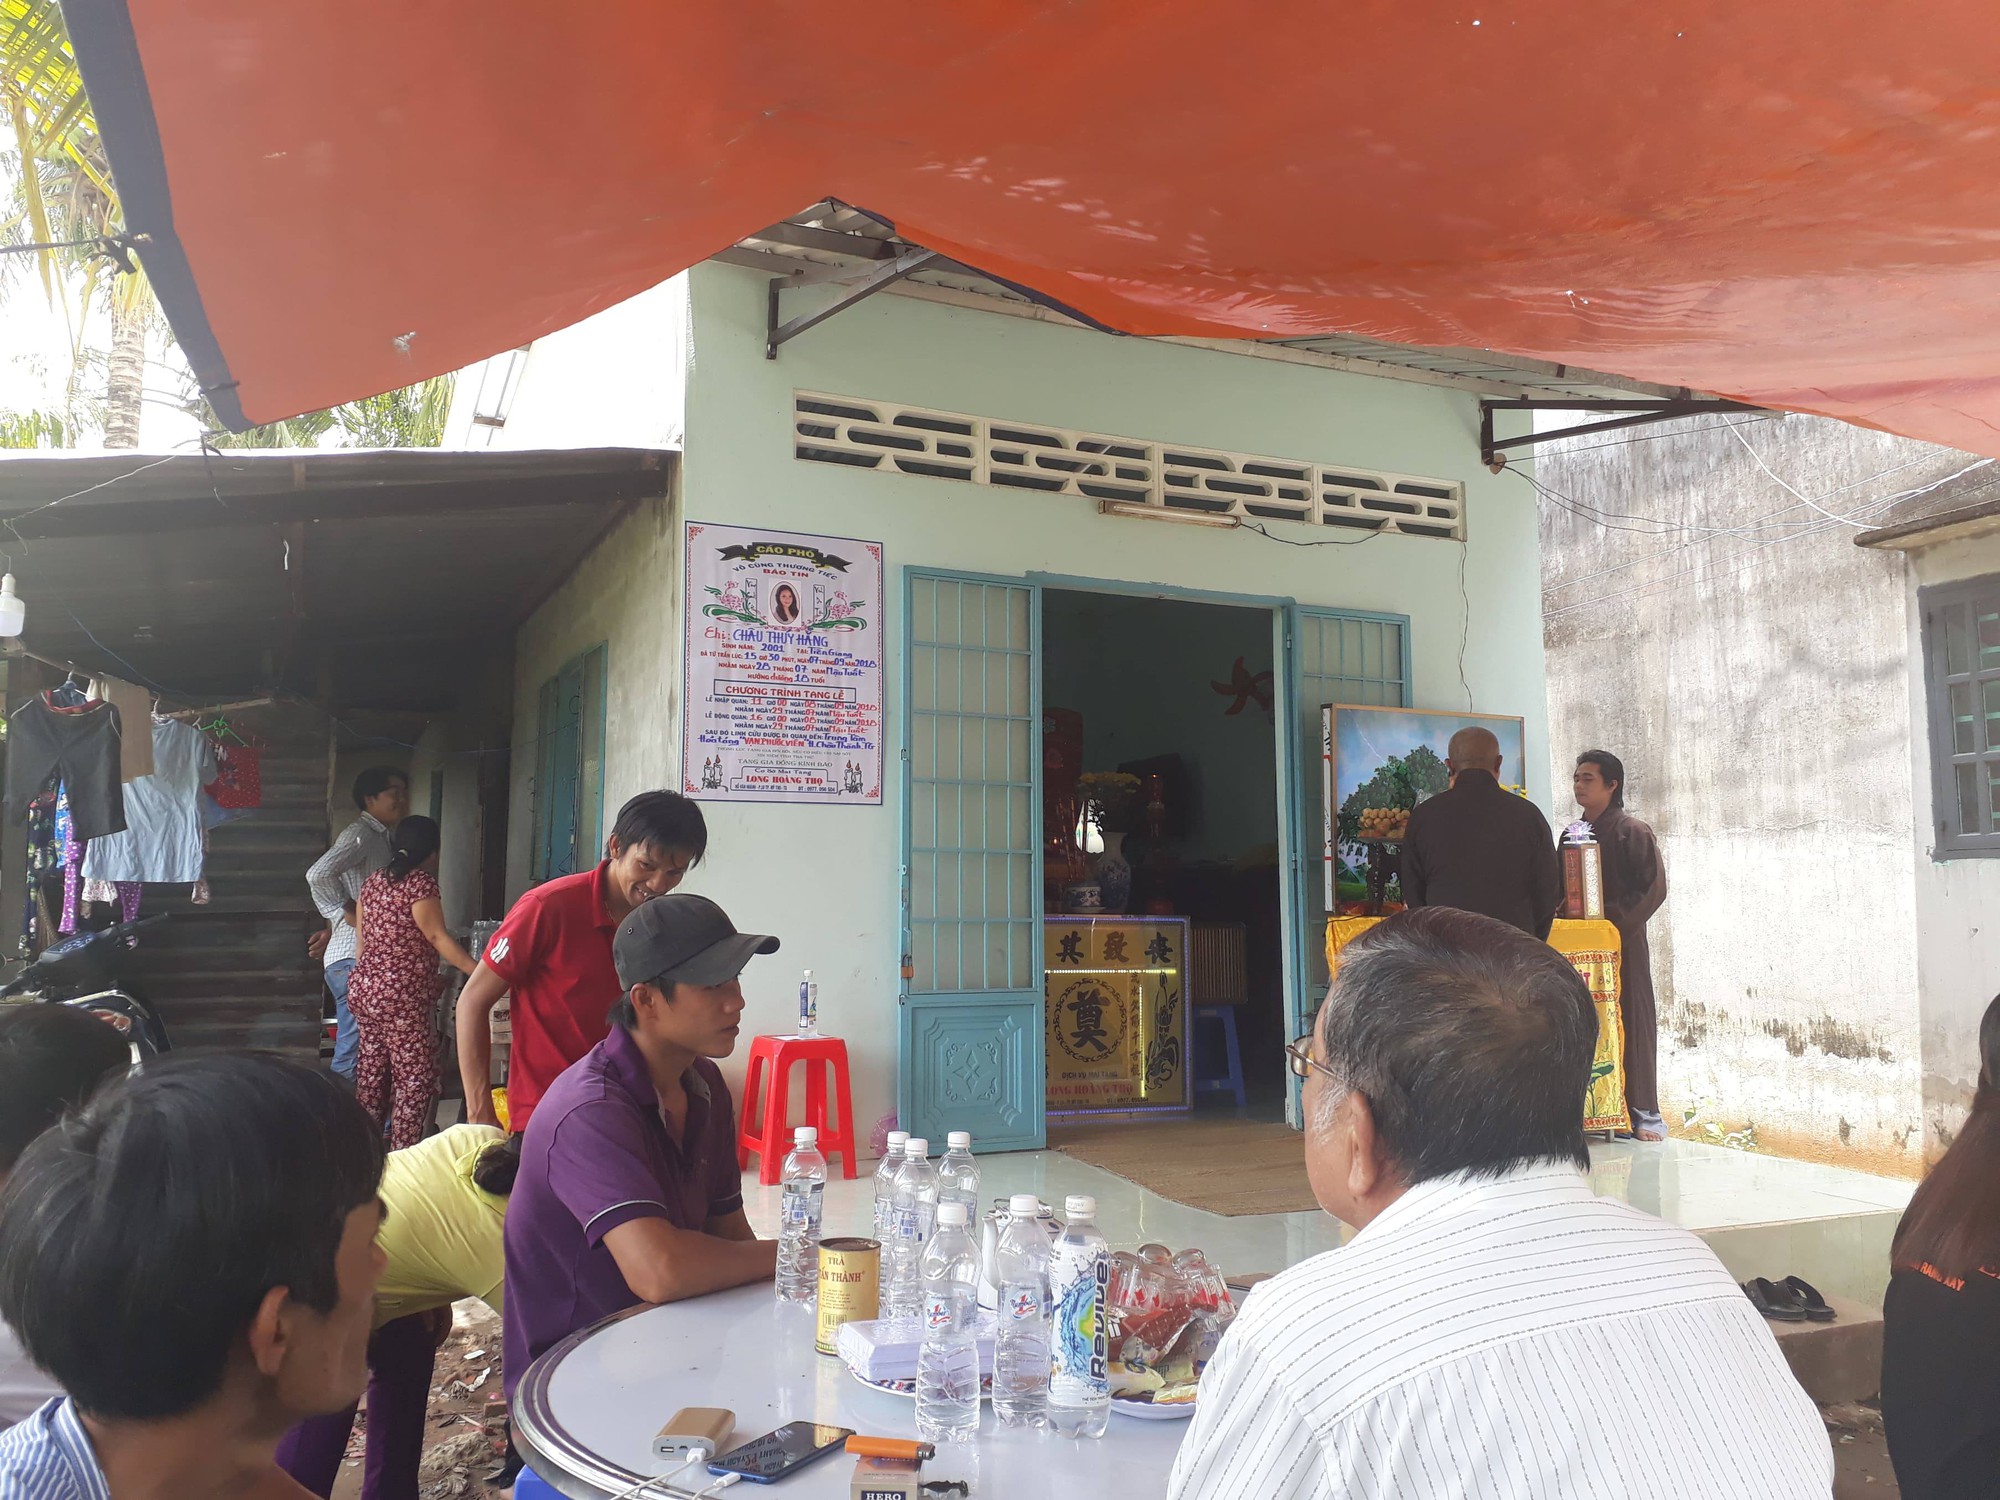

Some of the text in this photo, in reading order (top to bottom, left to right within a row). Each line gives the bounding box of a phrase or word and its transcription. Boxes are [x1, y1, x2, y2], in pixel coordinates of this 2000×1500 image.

[757, 545, 783, 553] CÁO
[777, 563, 814, 572] THƯƠNG
[818, 569, 837, 580] TIẾC
[733, 628, 763, 642] CHÂU
[761, 643, 784, 652] 2001
[756, 662, 770, 670] 28
[795, 665, 808, 673] 07
[809, 656, 818, 664] 07
[834, 658, 844, 666] 09
[855, 659, 877, 668] 2018
[794, 674, 809, 682] 18
[726, 686, 844, 700] CHƯƠNG TRÌNH TANG LỄ
[856, 703, 877, 711] 2018
[773, 775, 801, 784] HOÀNG
[805, 777, 823, 786] THỌ
[1067, 988, 1110, 1052] 奠
[828, 1256, 845, 1265] TRÀ
[1090, 1260, 1109, 1380] Revive
